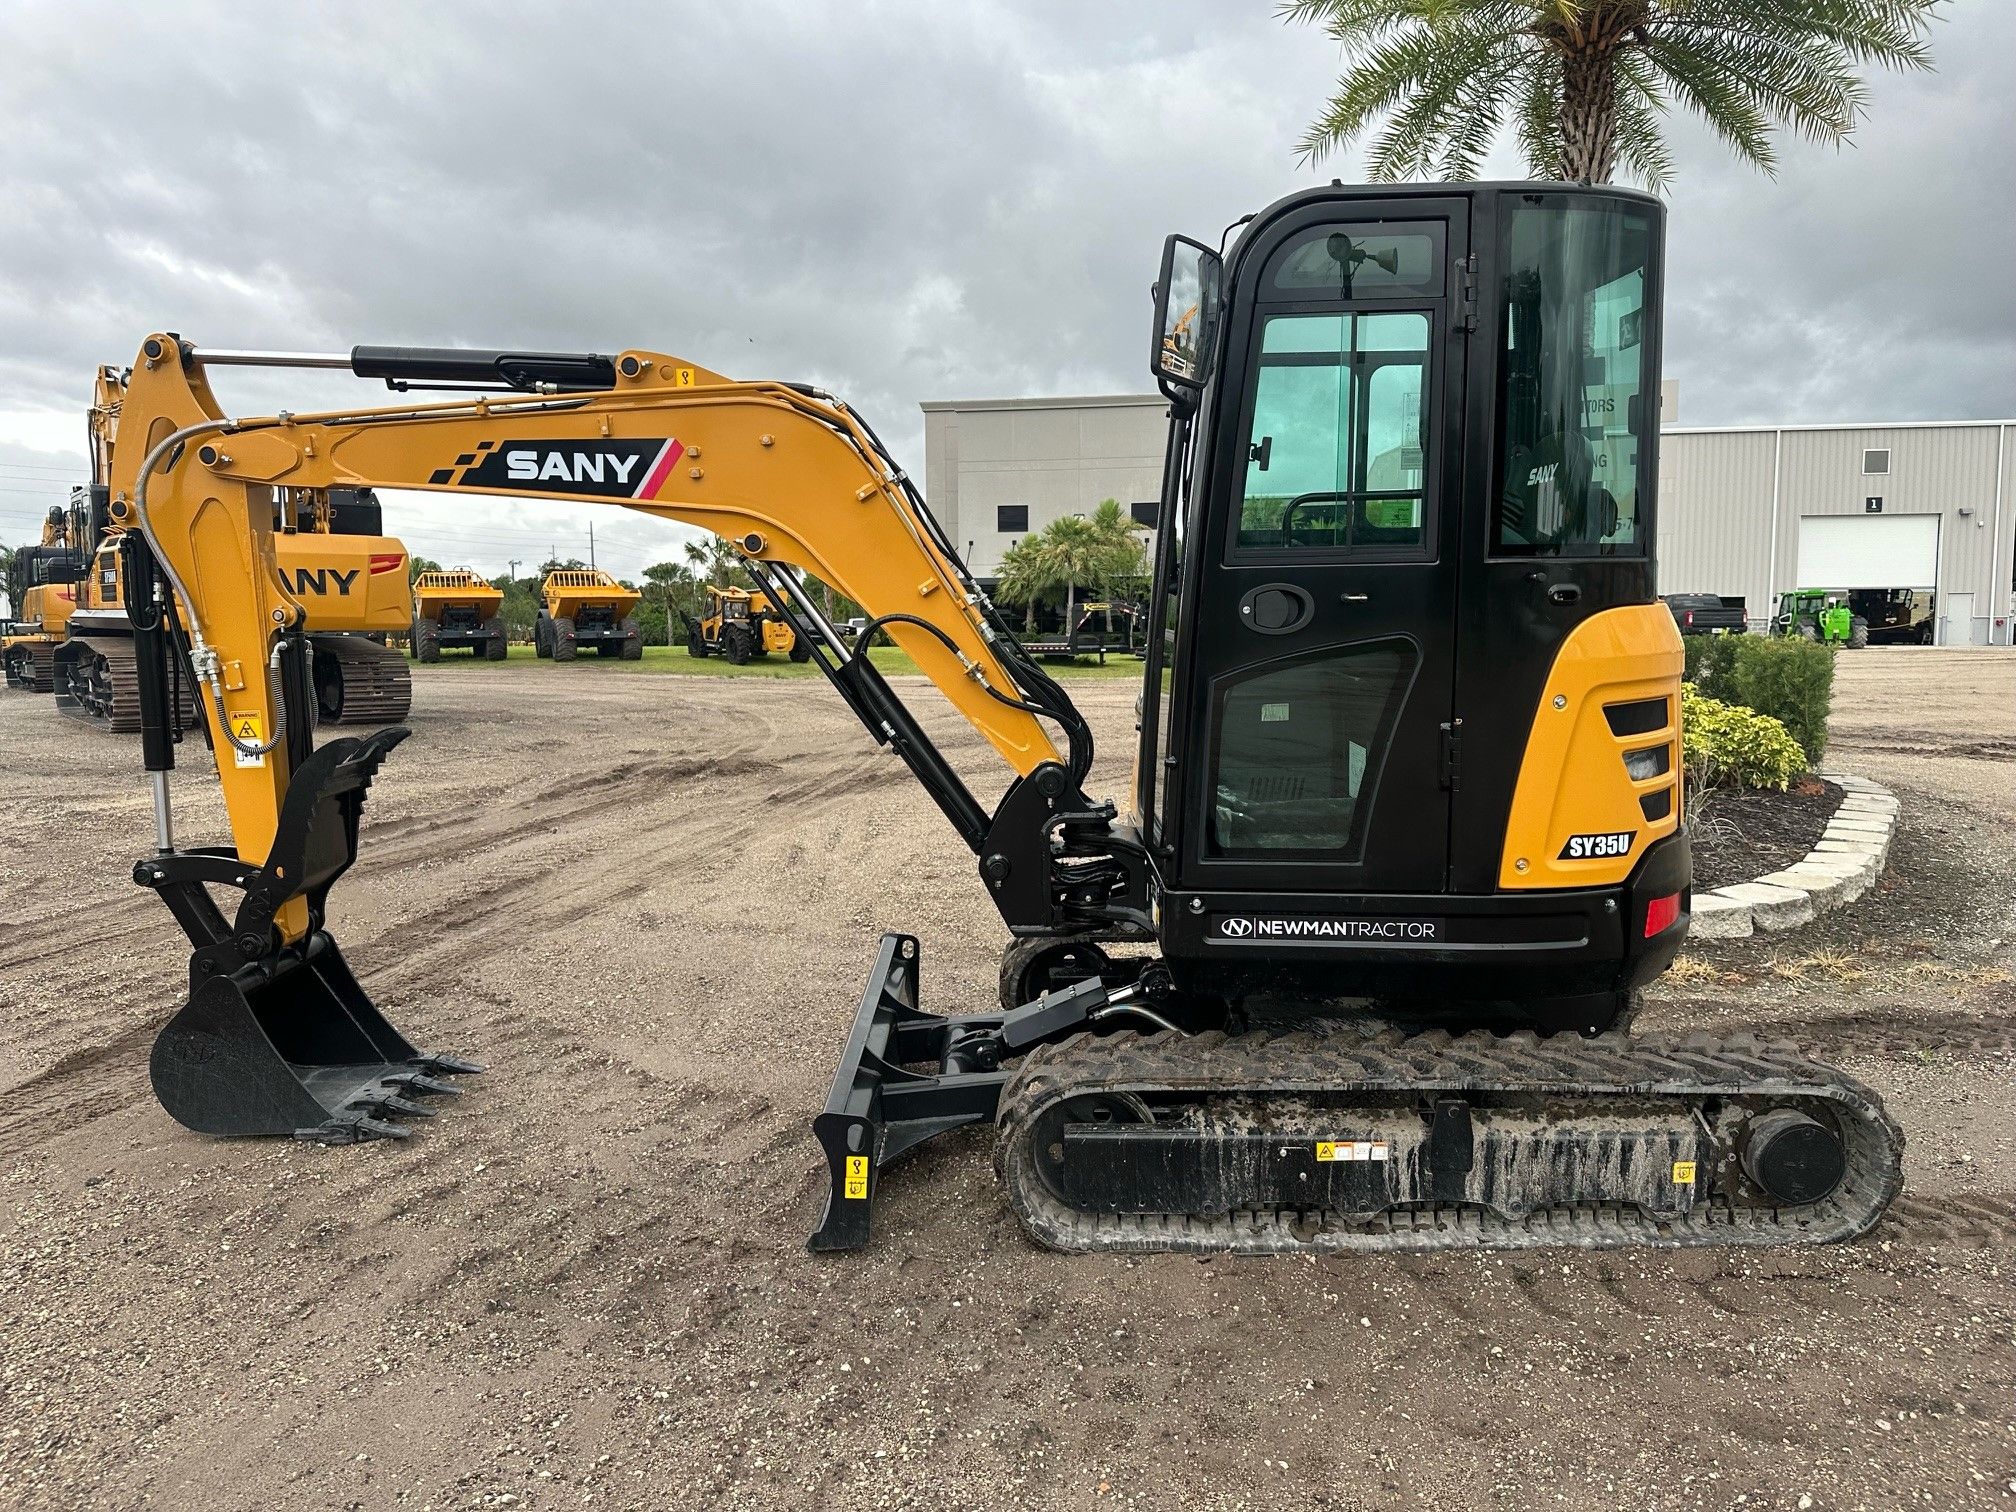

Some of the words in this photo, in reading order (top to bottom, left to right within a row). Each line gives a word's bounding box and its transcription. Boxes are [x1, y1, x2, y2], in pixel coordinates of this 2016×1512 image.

[507, 450, 640, 483] SANY
[1527, 462, 1559, 486] SANY
[1871, 499, 1877, 508] 1
[1569, 834, 1629, 857] SY35U
